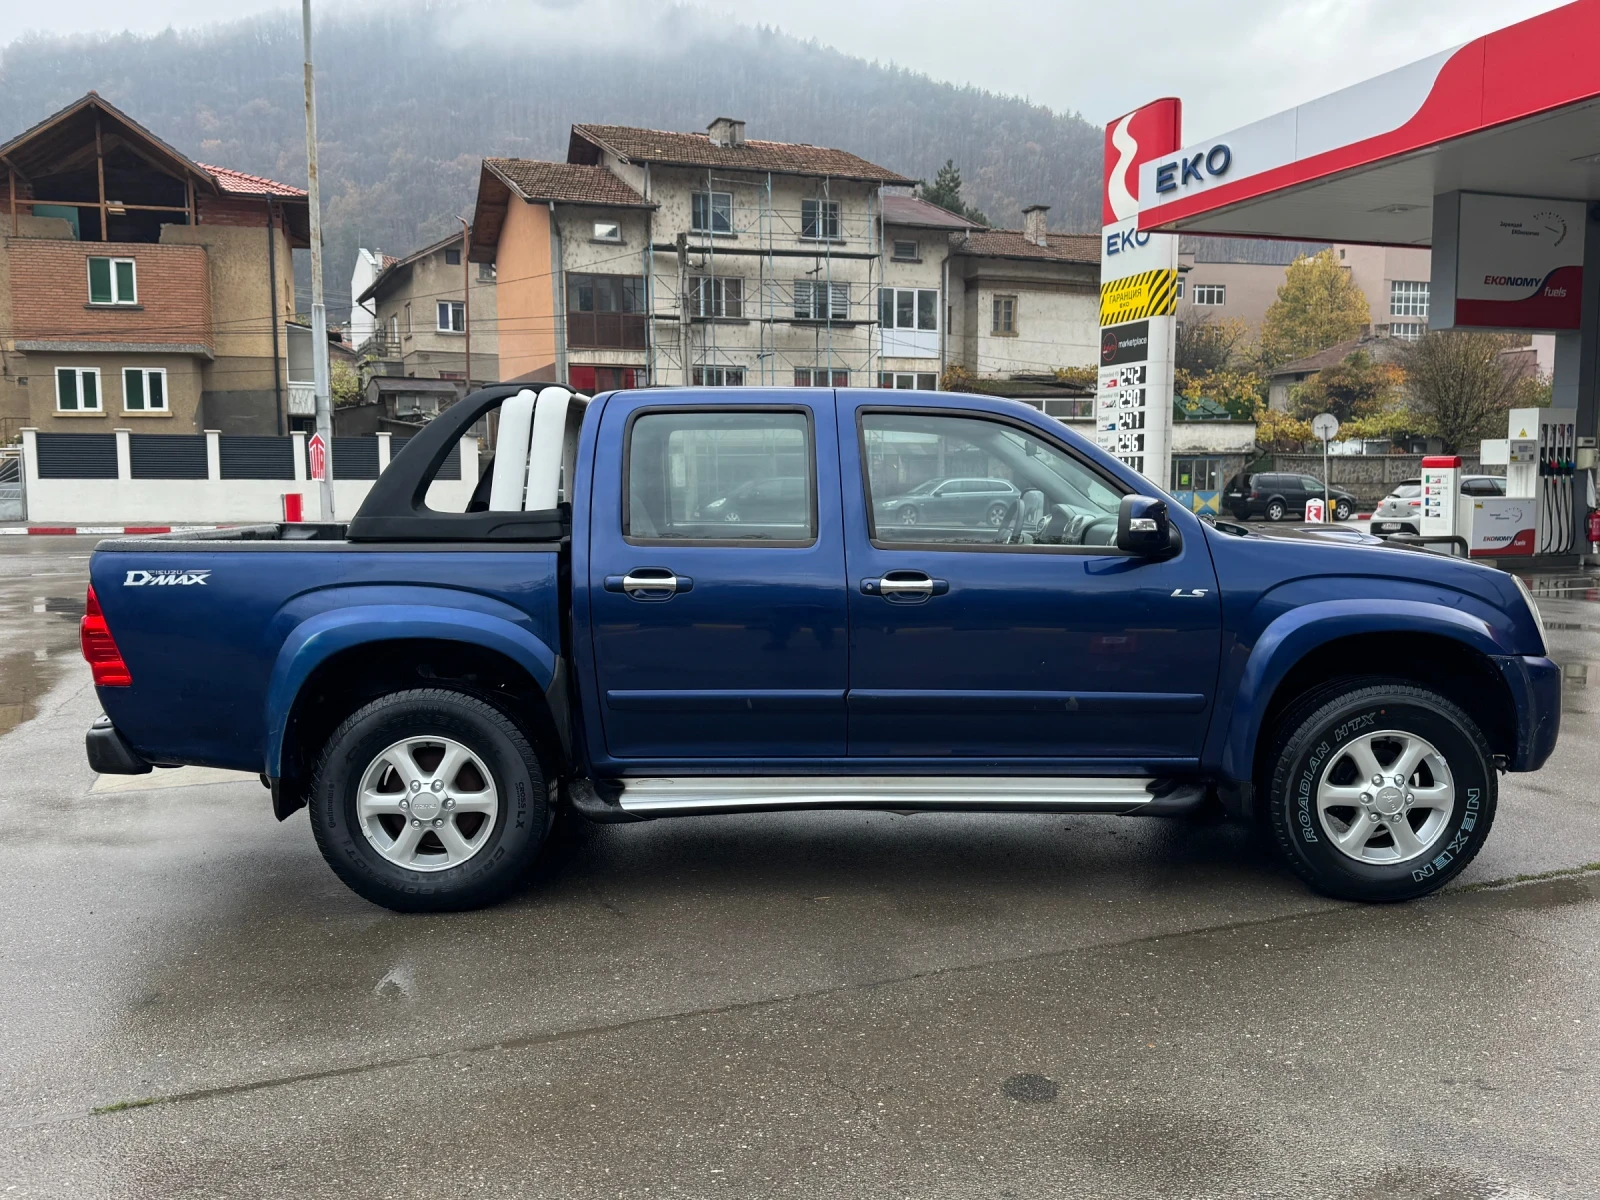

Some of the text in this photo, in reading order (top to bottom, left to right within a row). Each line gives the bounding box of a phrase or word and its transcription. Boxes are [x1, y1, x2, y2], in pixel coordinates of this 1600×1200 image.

[1156, 144, 1231, 193] EKO
[1107, 227, 1150, 256] EKO
[1109, 288, 1142, 304] ГАРАНЦИЯ
[1484, 275, 1567, 297] EKONOMY fuels
[1118, 337, 1147, 348] marketplace
[1120, 366, 1141, 387] 2.42
[1119, 389, 1140, 409] 2.90
[1118, 411, 1140, 430] 2.47
[1118, 434, 1139, 452] 2.96
[1170, 588, 1208, 597] LS
[1297, 711, 1377, 843] ROADIAN HTX
[327, 789, 337, 828] Continental
[515, 782, 527, 829] CROSS LX
[1412, 788, 1480, 882] NEXEN
